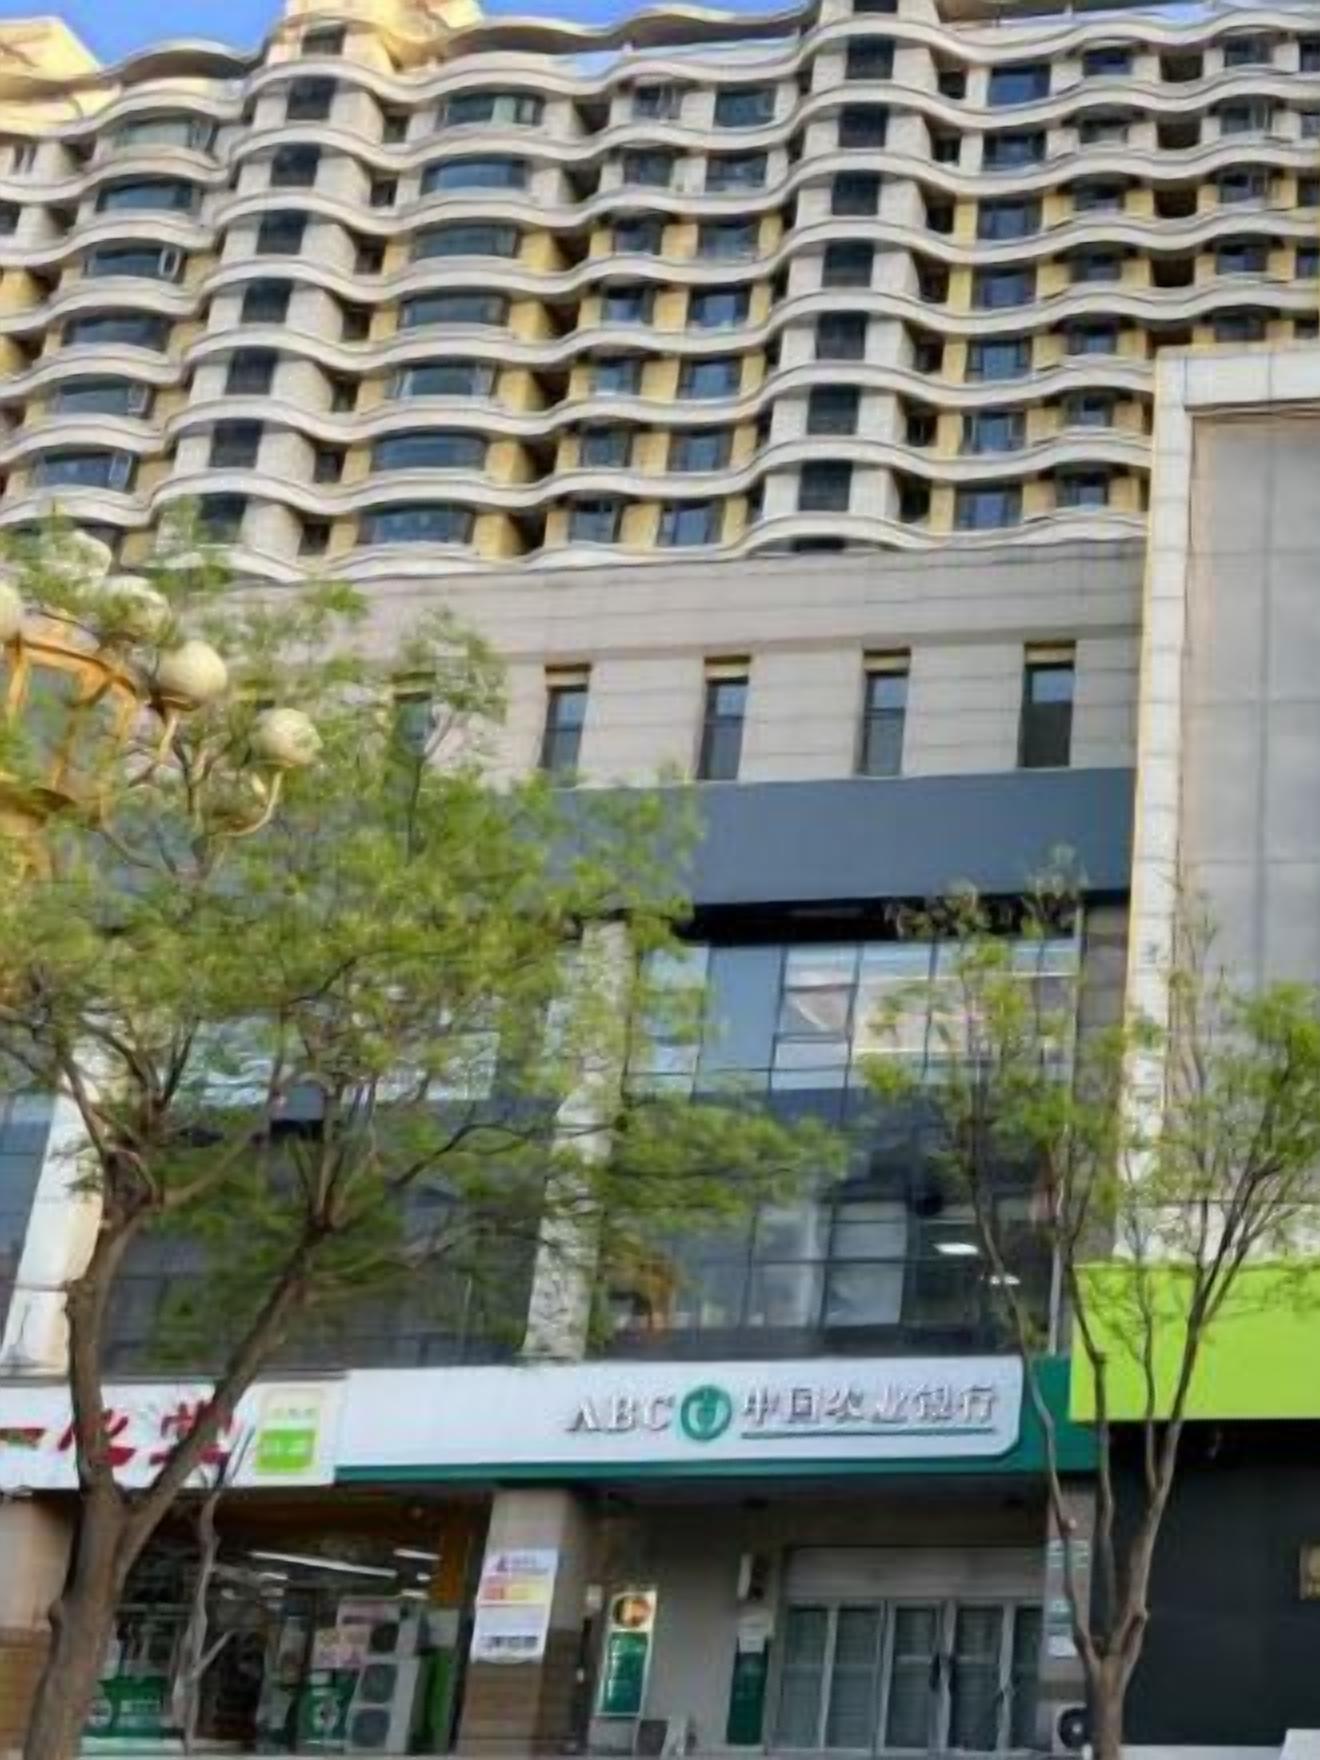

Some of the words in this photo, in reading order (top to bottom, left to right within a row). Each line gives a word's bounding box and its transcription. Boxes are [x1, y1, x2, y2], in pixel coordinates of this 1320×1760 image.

[567, 1392, 672, 1433] ABC
[743, 1382, 993, 1426] 中国农业银行
